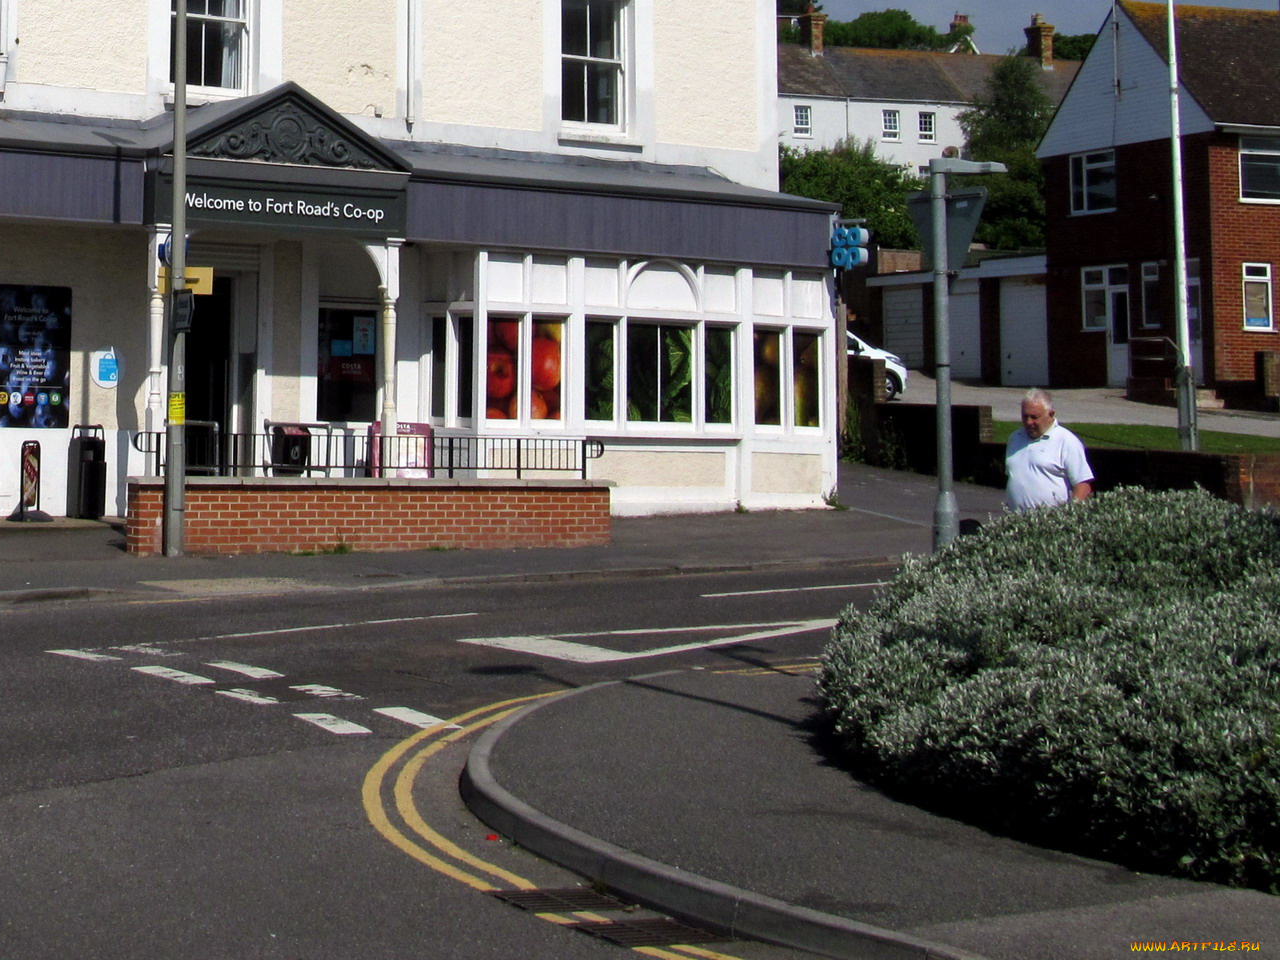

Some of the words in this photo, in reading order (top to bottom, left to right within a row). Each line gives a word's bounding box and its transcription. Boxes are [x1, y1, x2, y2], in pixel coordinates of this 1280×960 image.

[184, 192, 244, 211] Welcome
[248, 198, 262, 212] to
[266, 198, 293, 215] Fort
[297, 200, 340, 218] Road's
[344, 203, 384, 223] Co-op
